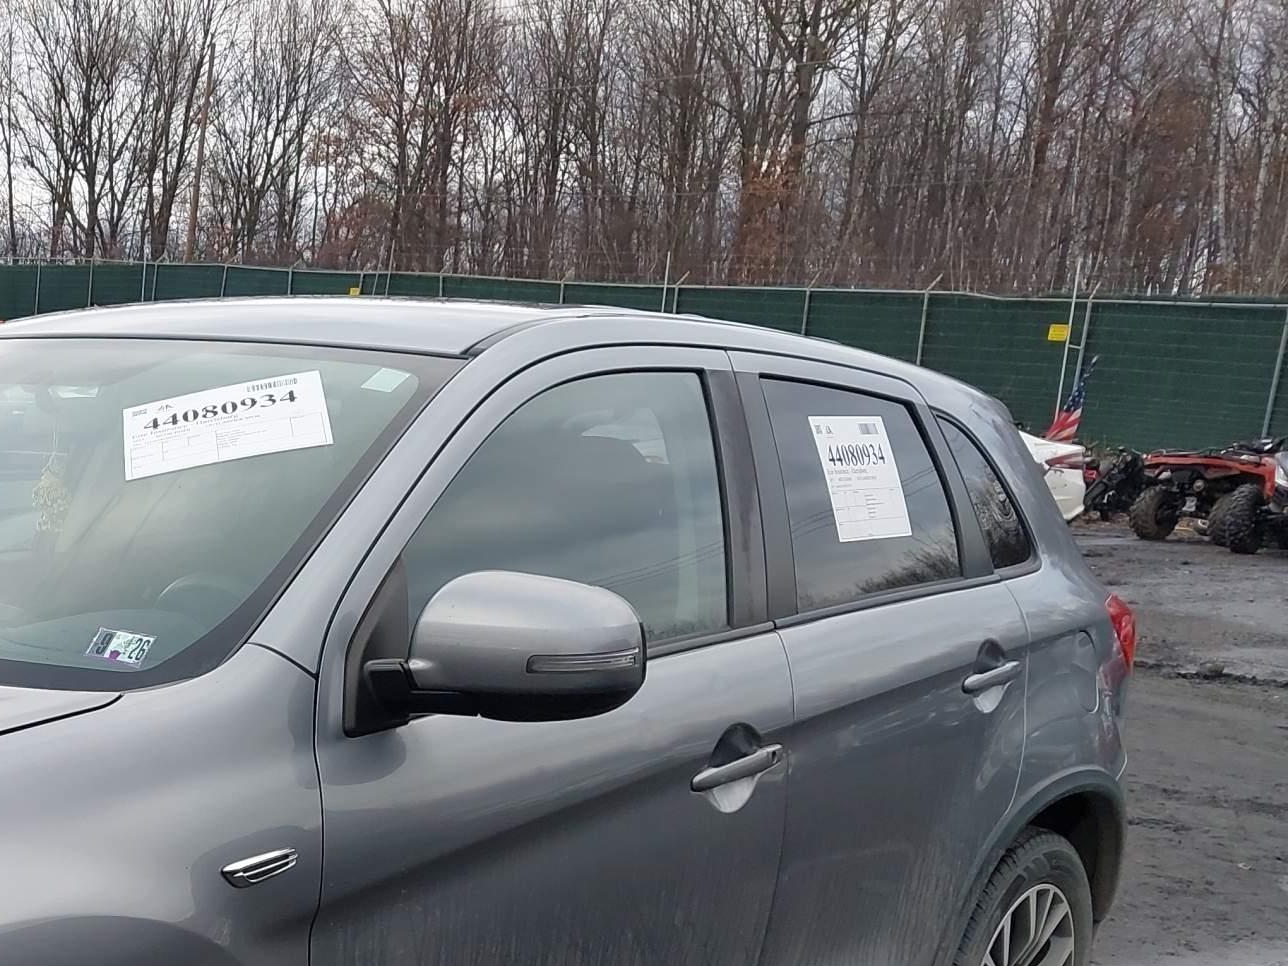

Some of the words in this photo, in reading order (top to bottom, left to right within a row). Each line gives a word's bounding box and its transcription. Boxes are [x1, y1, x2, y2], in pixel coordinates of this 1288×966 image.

[143, 389, 298, 430] 44080934
[828, 443, 886, 466] 44080934
[96, 633, 113, 654] 9
[128, 638, 151, 660] 26
